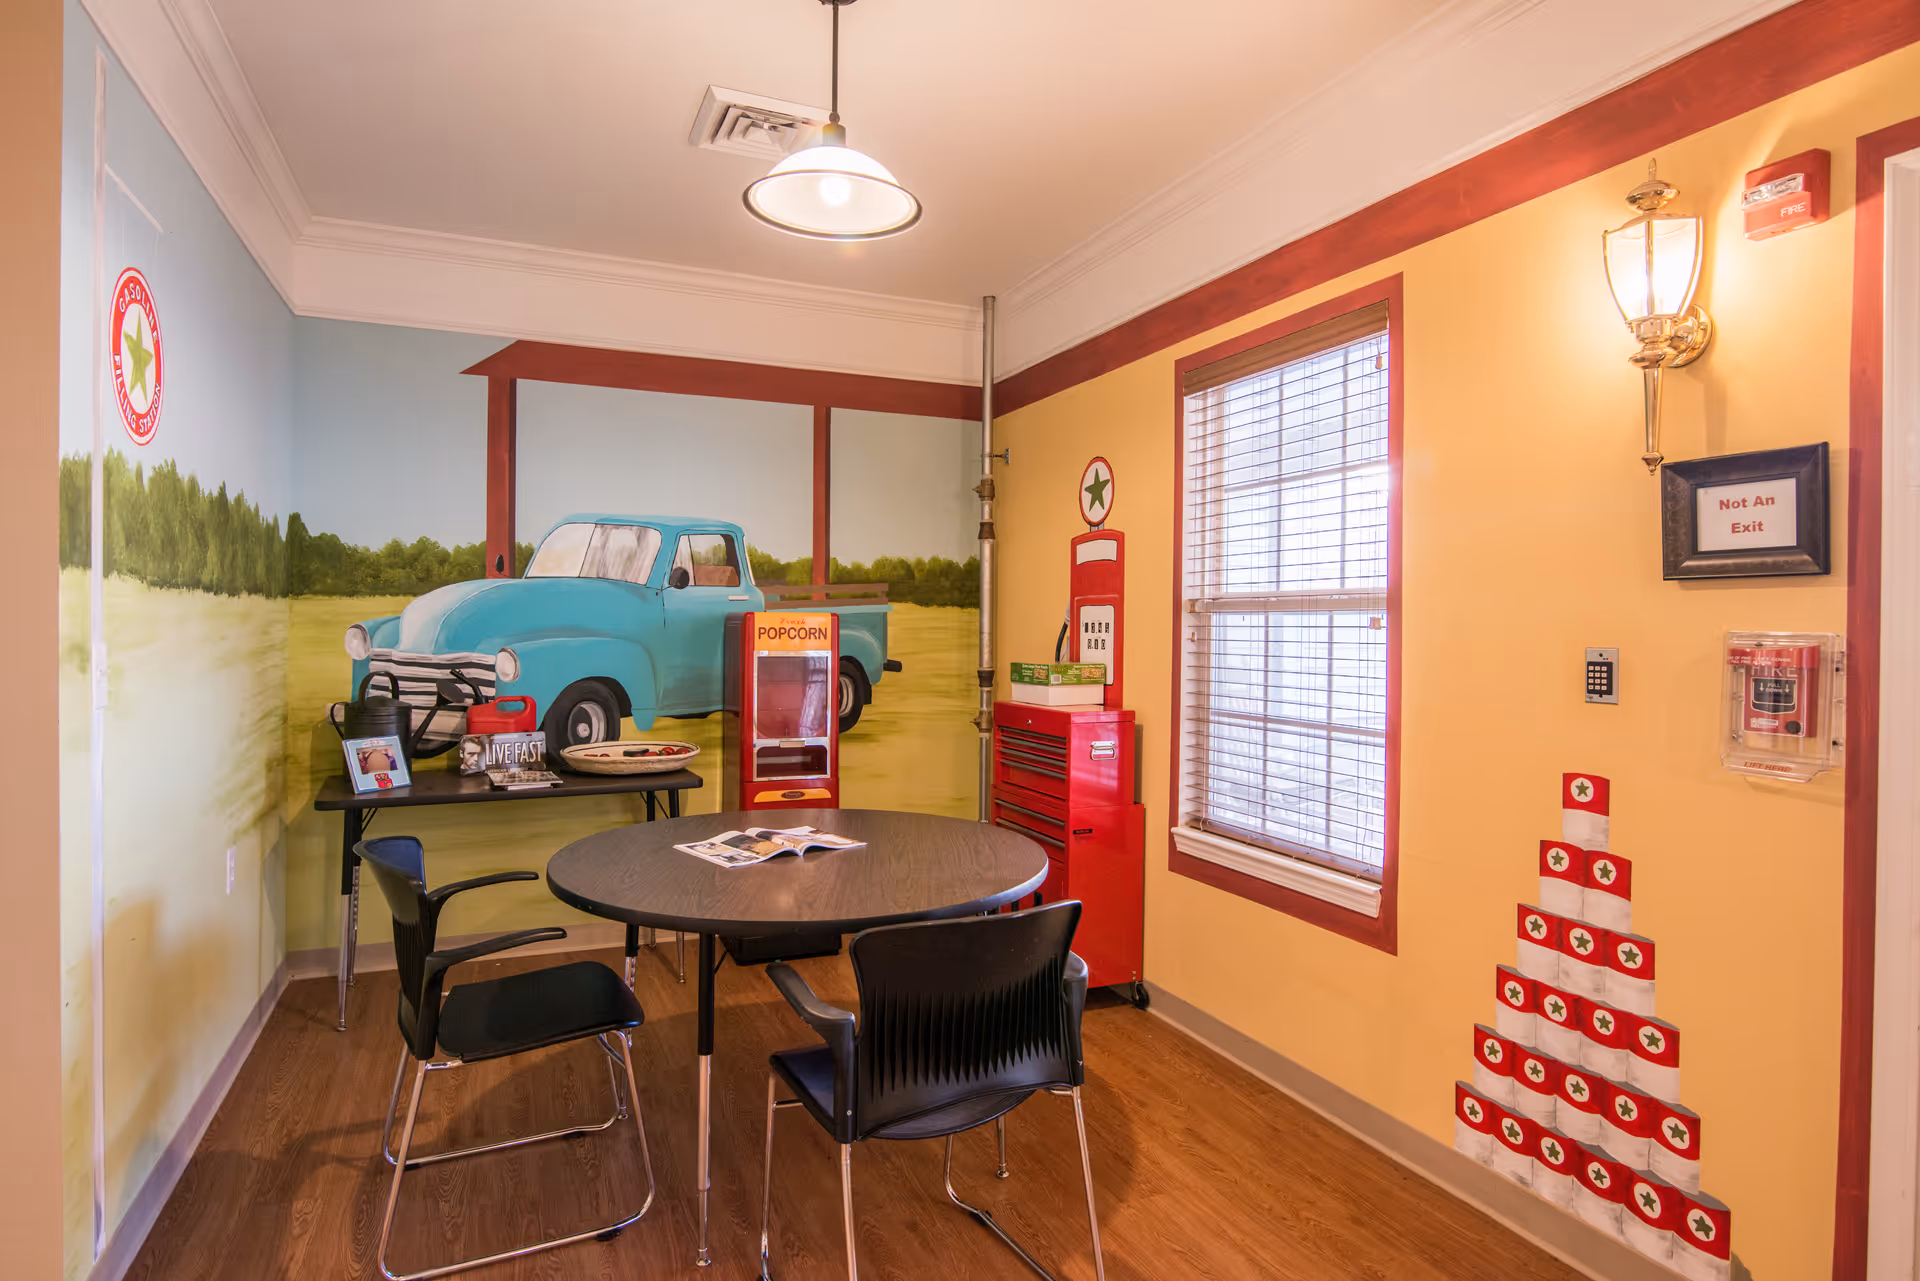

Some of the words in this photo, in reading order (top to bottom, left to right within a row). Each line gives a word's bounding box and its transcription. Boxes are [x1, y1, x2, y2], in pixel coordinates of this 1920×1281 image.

[1781, 202, 1806, 217] FIRE
[119, 282, 158, 344] GASOLINE
[114, 354, 137, 430] FILLING
[139, 383, 161, 434] STATION
[1719, 498, 1748, 510] Not
[1753, 495, 1775, 507] An
[1731, 520, 1764, 534] Exit
[758, 627, 828, 640] POPCORN
[1751, 665, 1798, 677] FIRE
[485, 743, 512, 765] LIVE
[514, 741, 543, 763] FAST
